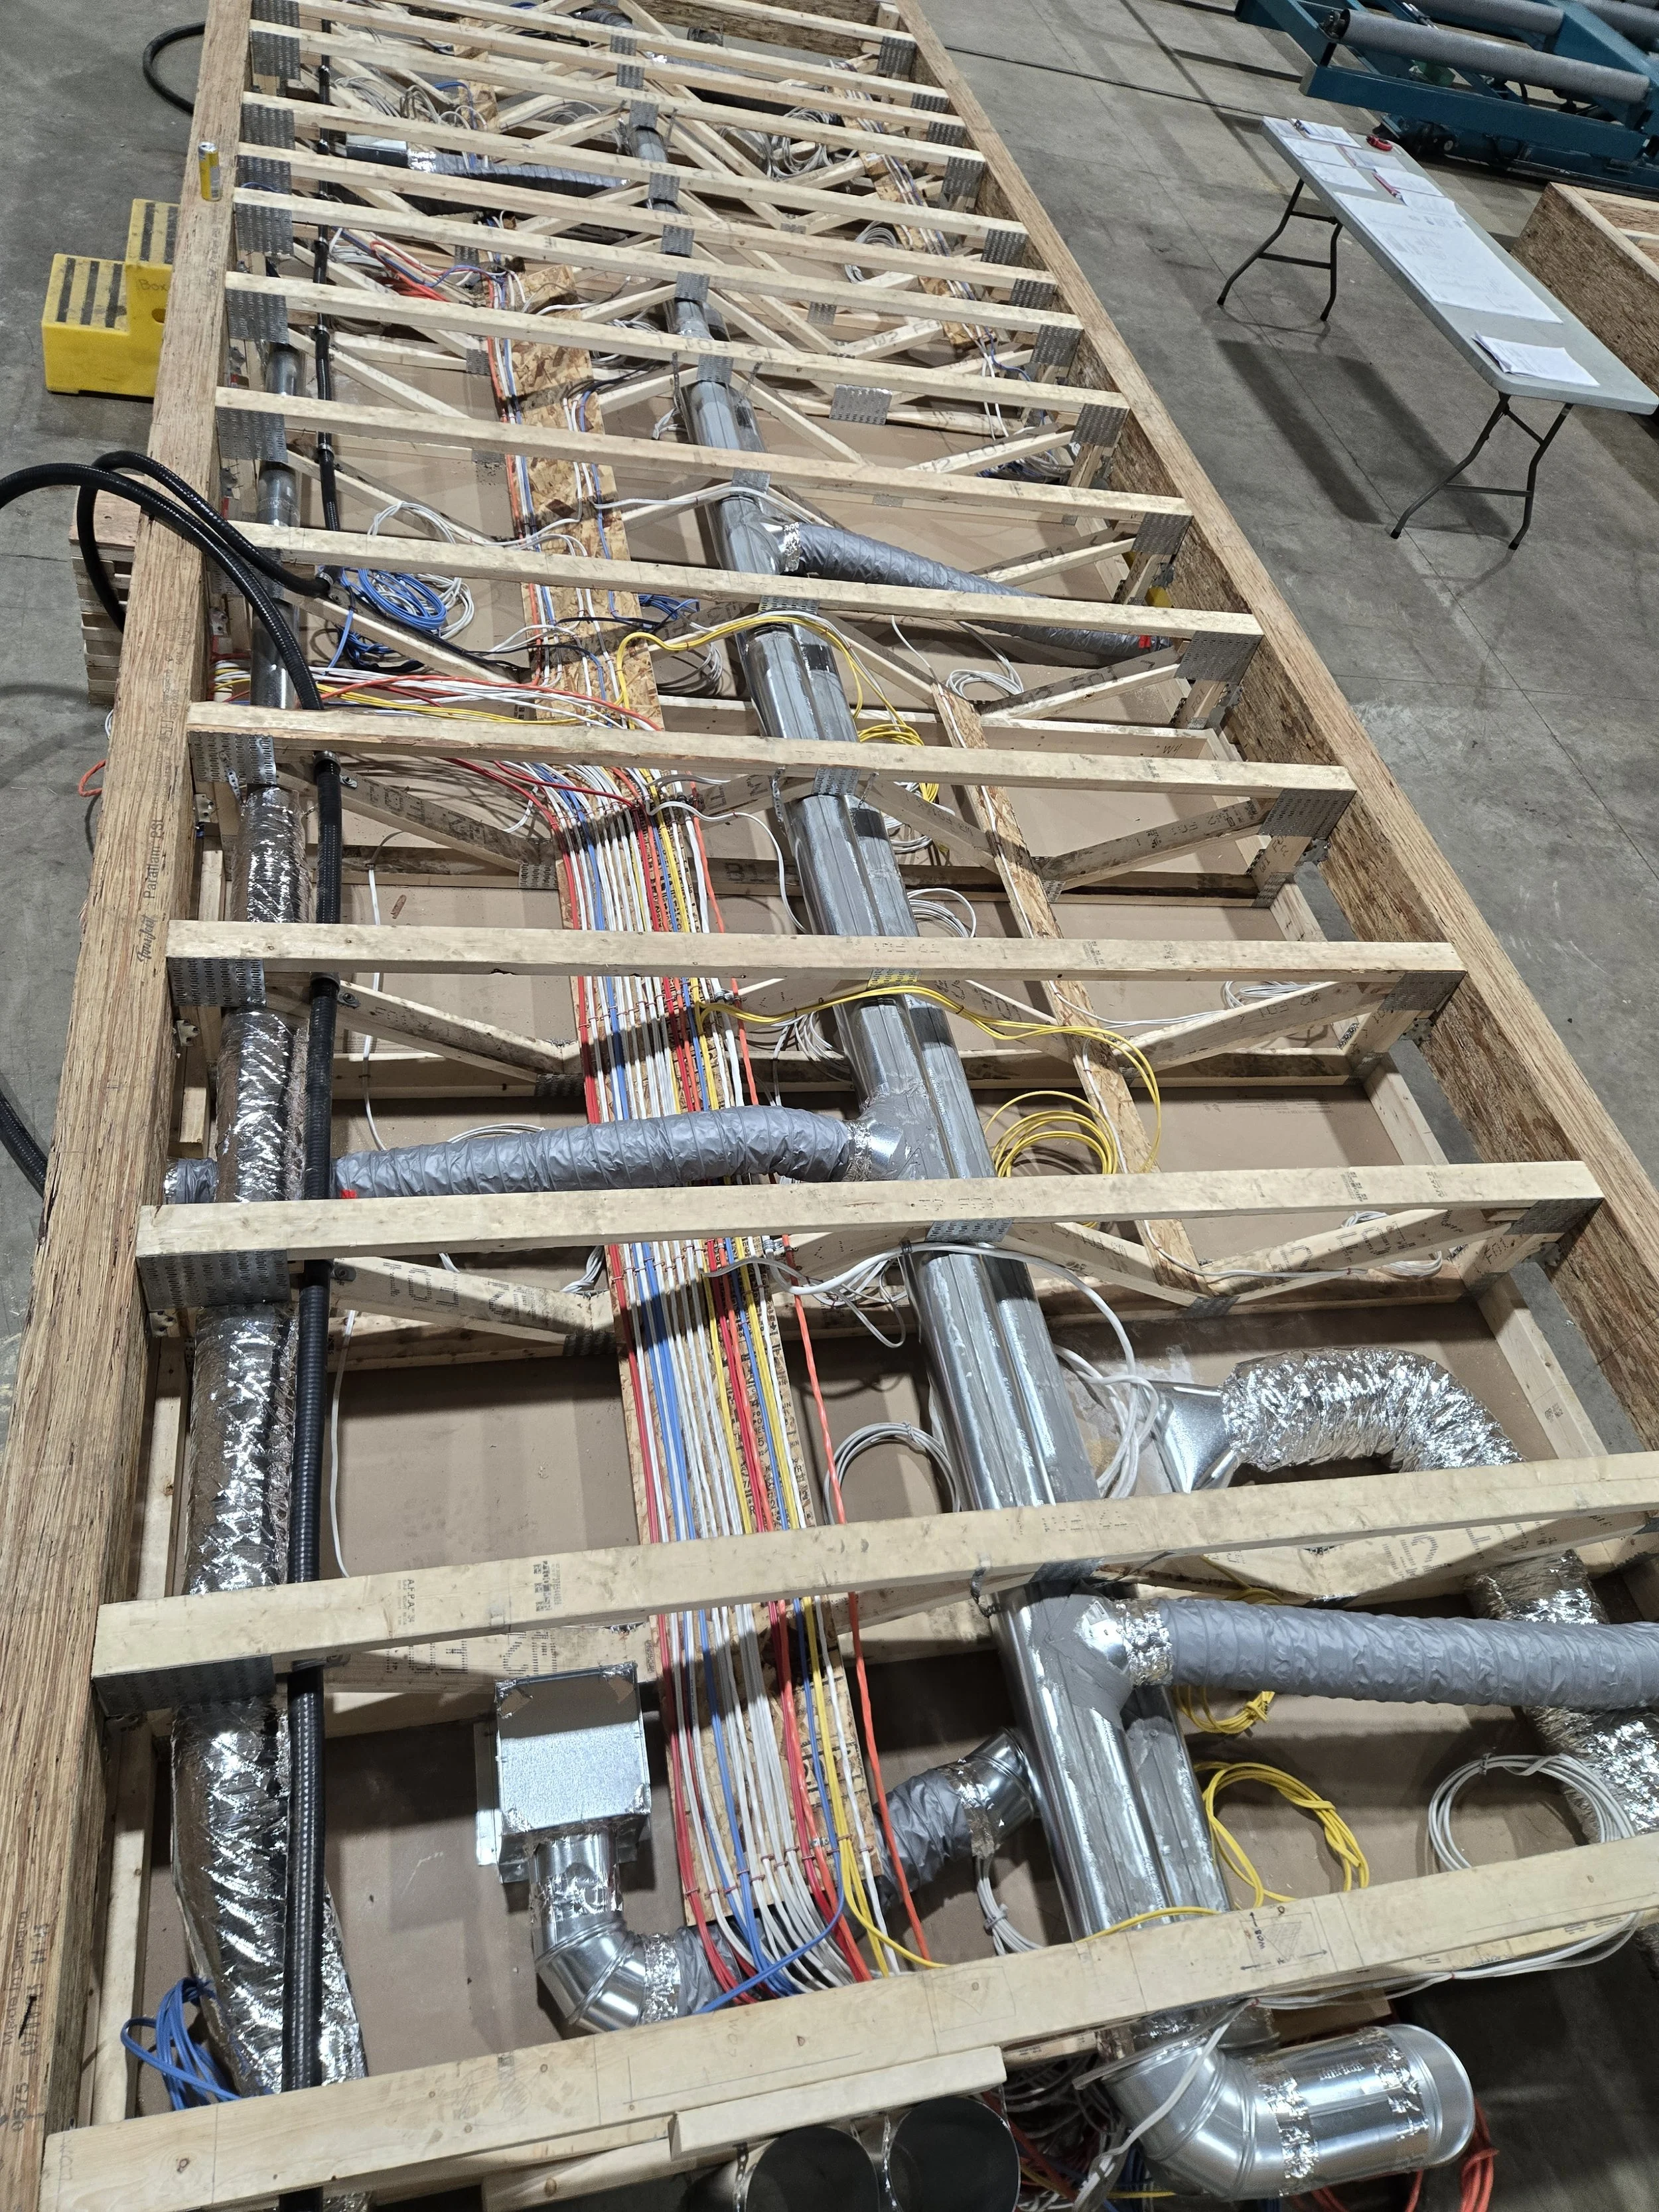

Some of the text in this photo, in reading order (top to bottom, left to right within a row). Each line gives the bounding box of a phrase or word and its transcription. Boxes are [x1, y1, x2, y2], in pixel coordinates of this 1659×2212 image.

[138, 279, 168, 291] Box
[150, 816, 164, 839] PSL
[382, 1262, 460, 1308] F01
[2, 1995, 17, 2047] Made
